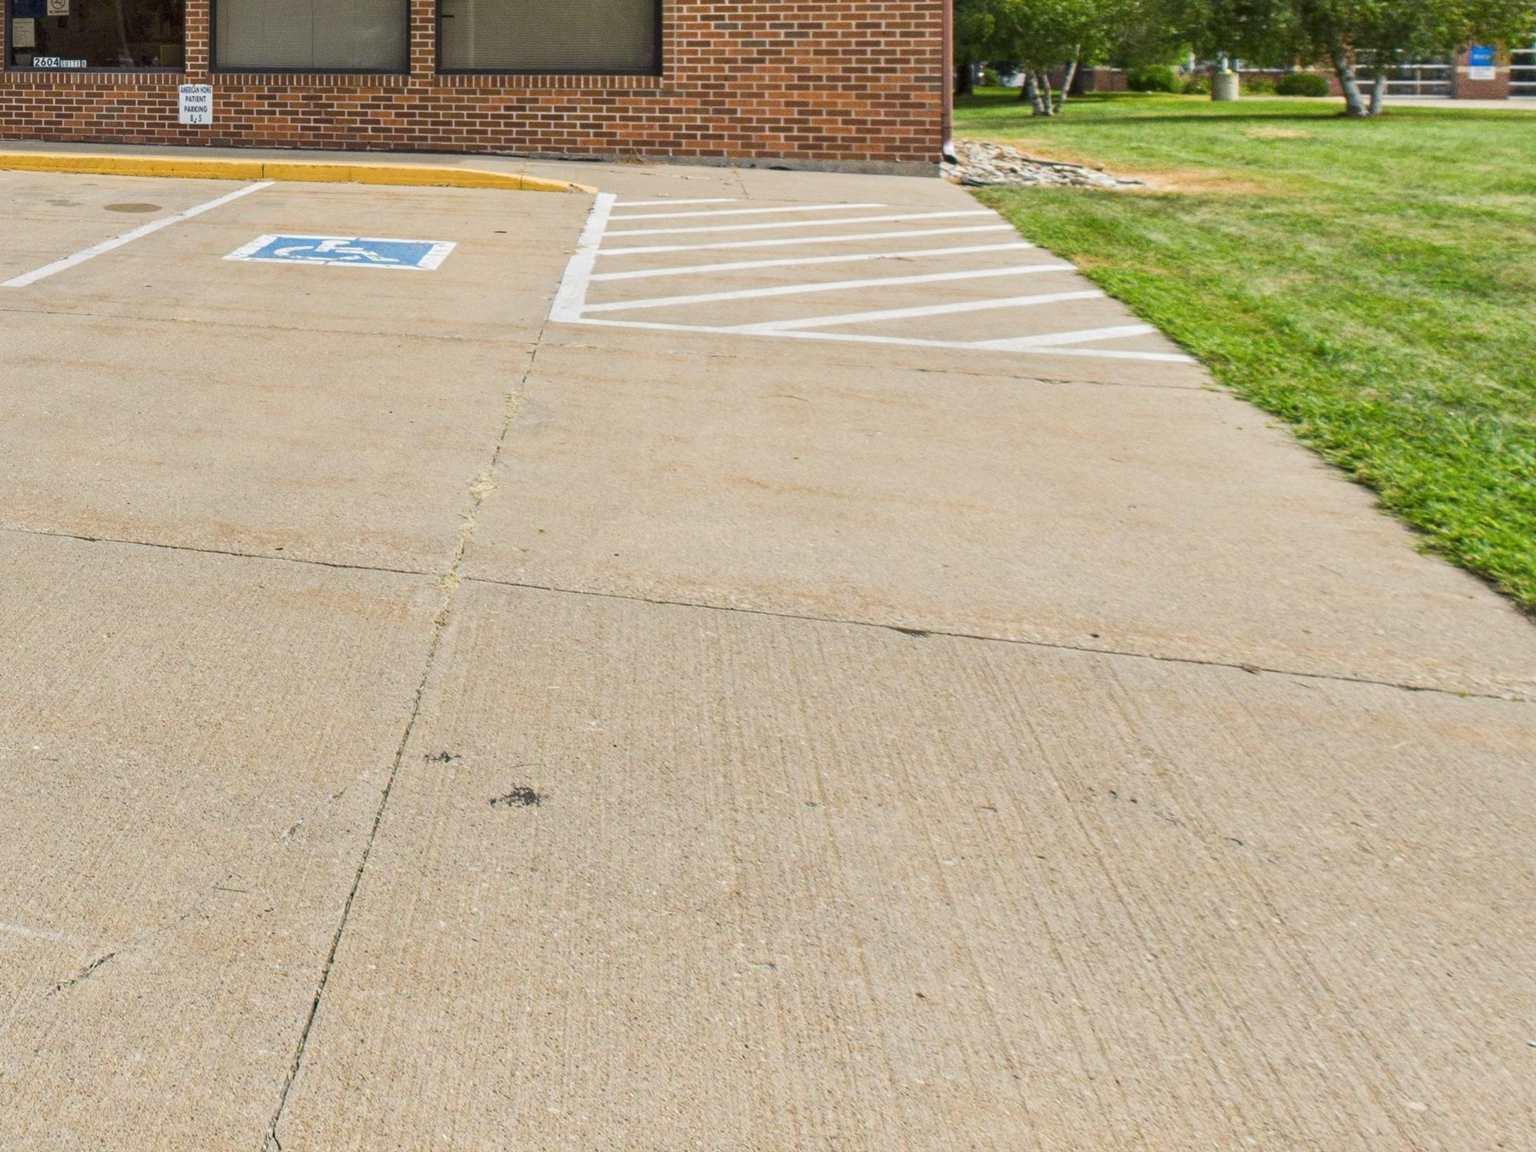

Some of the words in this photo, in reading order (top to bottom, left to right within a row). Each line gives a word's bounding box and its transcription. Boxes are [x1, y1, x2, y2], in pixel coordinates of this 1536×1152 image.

[34, 57, 59, 68] 2604
[185, 95, 207, 103] PATIENT
[184, 105, 208, 113] PARKING
